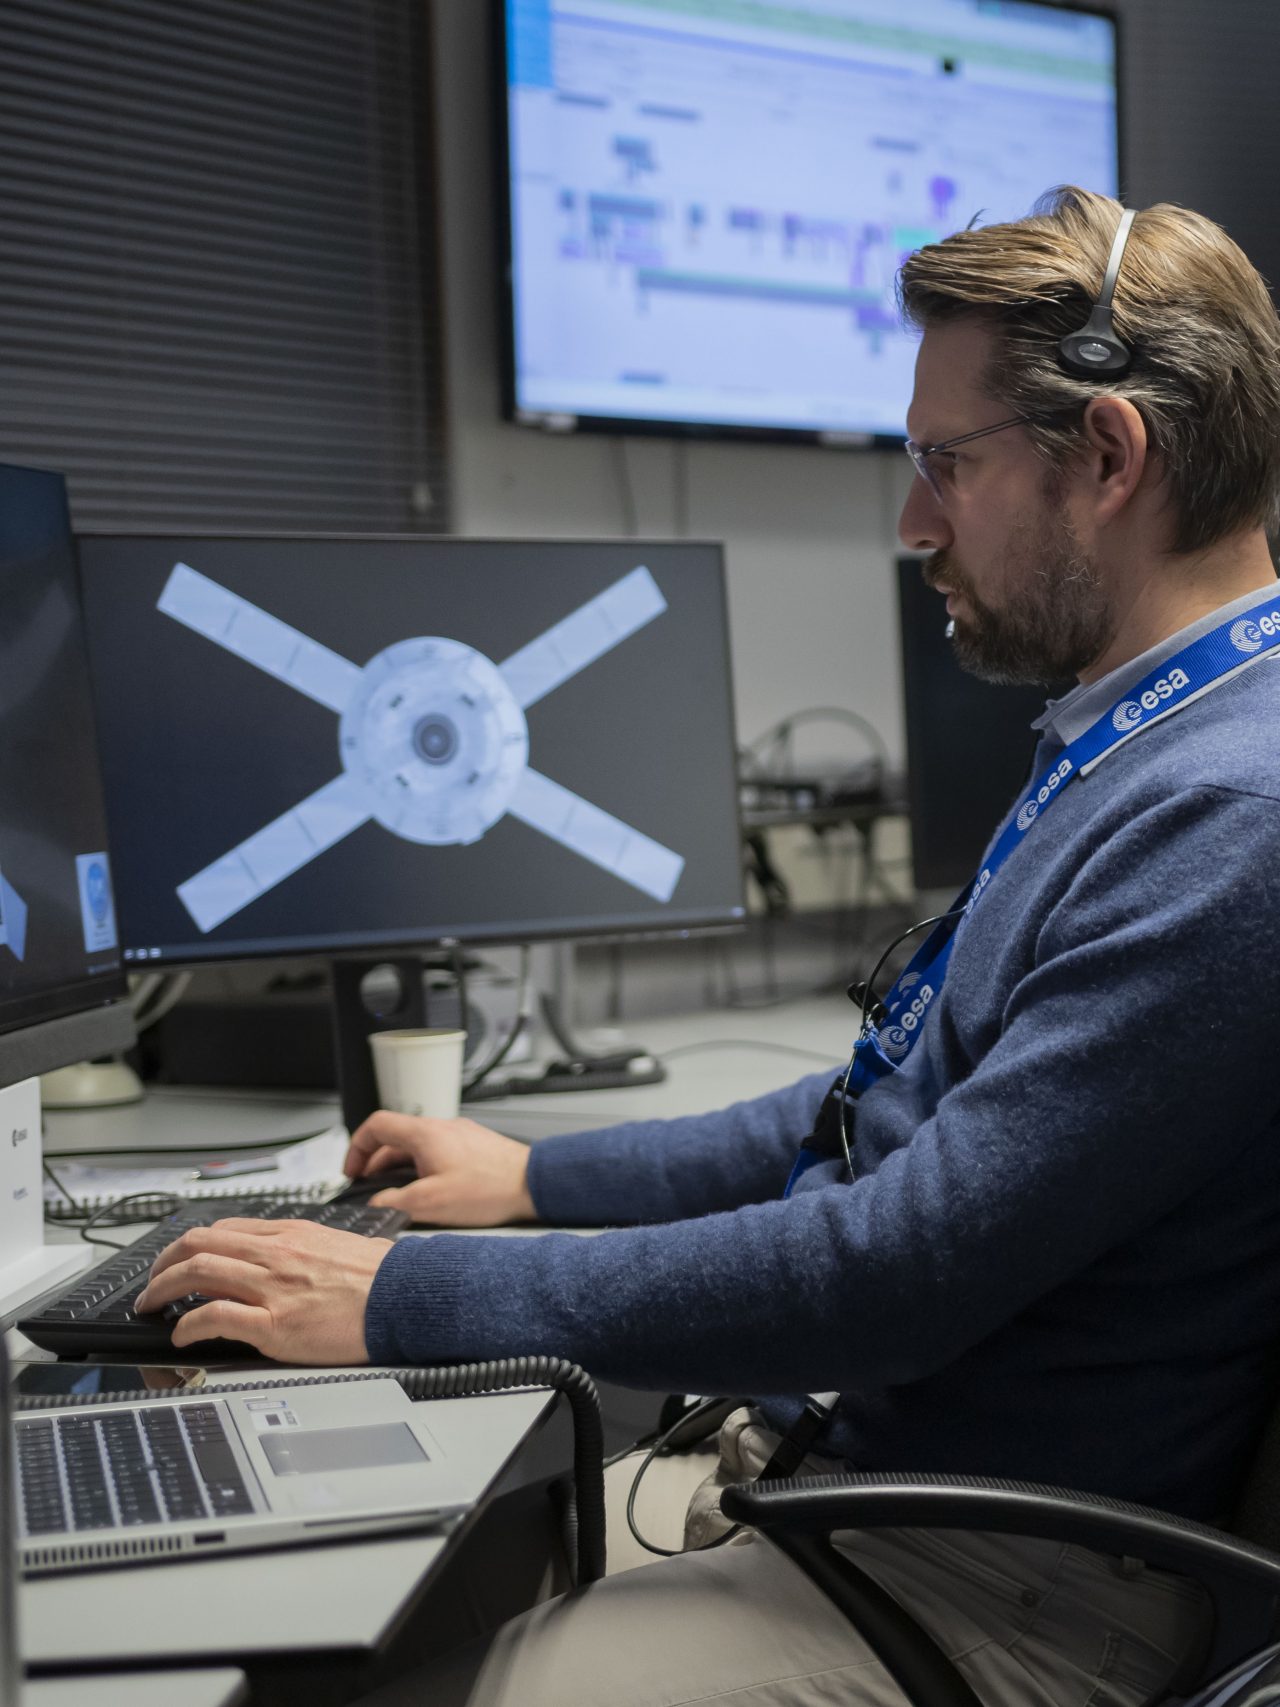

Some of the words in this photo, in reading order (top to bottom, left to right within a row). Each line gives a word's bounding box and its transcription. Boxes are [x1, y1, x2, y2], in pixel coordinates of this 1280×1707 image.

[1141, 668, 1190, 710] esa
[1038, 759, 1073, 804] esa
[901, 985, 934, 1031] esa
